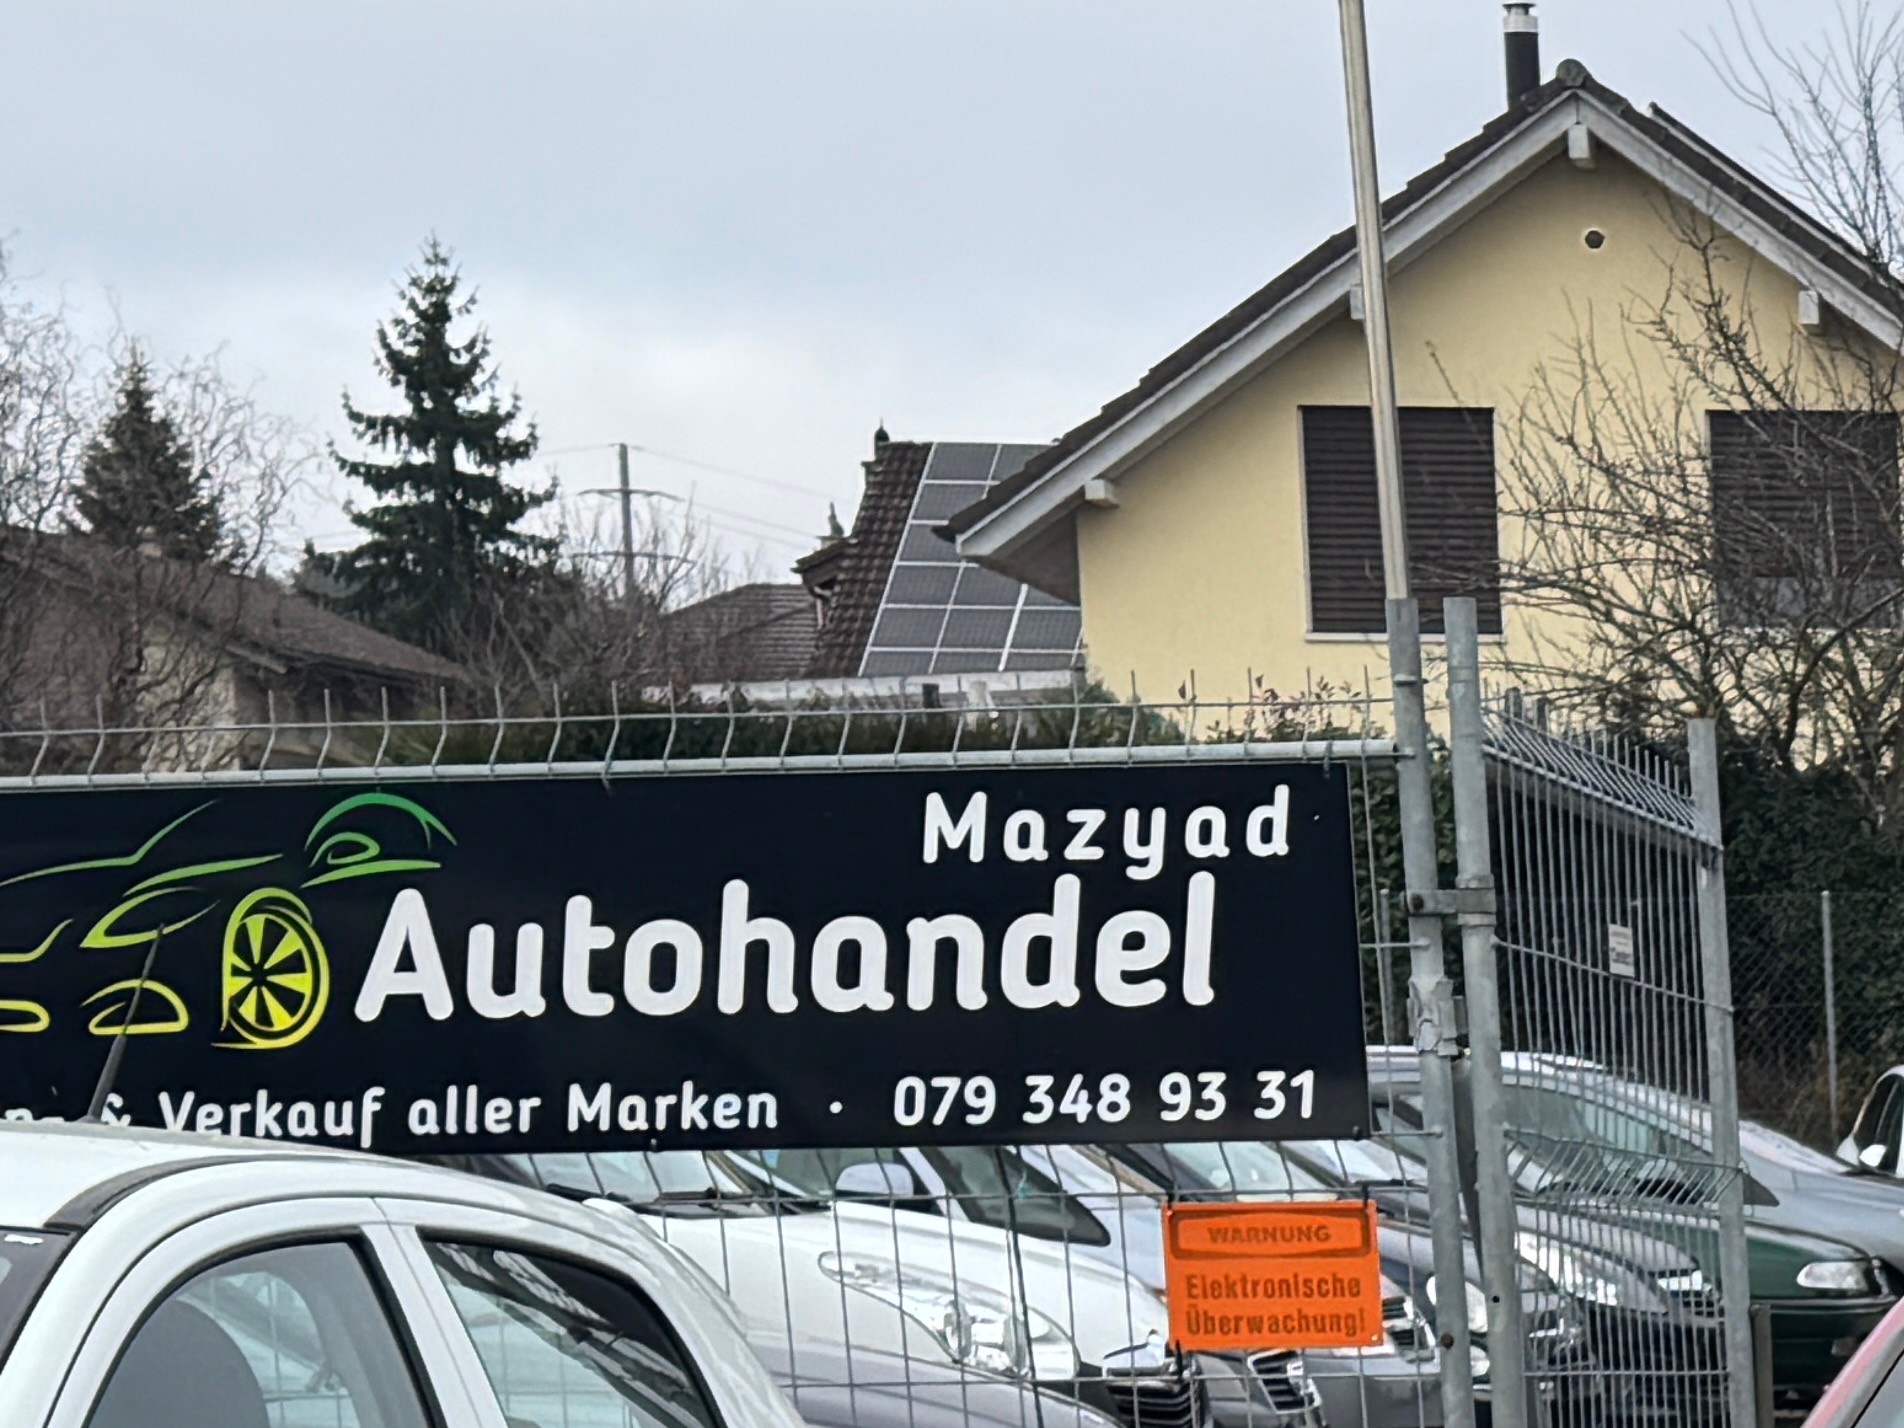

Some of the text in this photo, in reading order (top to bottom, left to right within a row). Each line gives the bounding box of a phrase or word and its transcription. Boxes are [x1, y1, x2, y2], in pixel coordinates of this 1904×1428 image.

[922, 784, 1290, 882] Mazyad
[354, 873, 1216, 1023] Autohandel
[158, 1085, 386, 1149] Verkauf
[408, 1085, 542, 1136] aller
[567, 1080, 778, 1132] Marken
[894, 1076, 996, 1126] 079
[1022, 1074, 1131, 1124] 348
[1159, 1072, 1227, 1122] 93
[1253, 1069, 1314, 1120] 31
[1207, 1225, 1332, 1244] WARNUNG
[1186, 1272, 1361, 1300] Elektronische
[1186, 1303, 1366, 1337] Überwachung!
